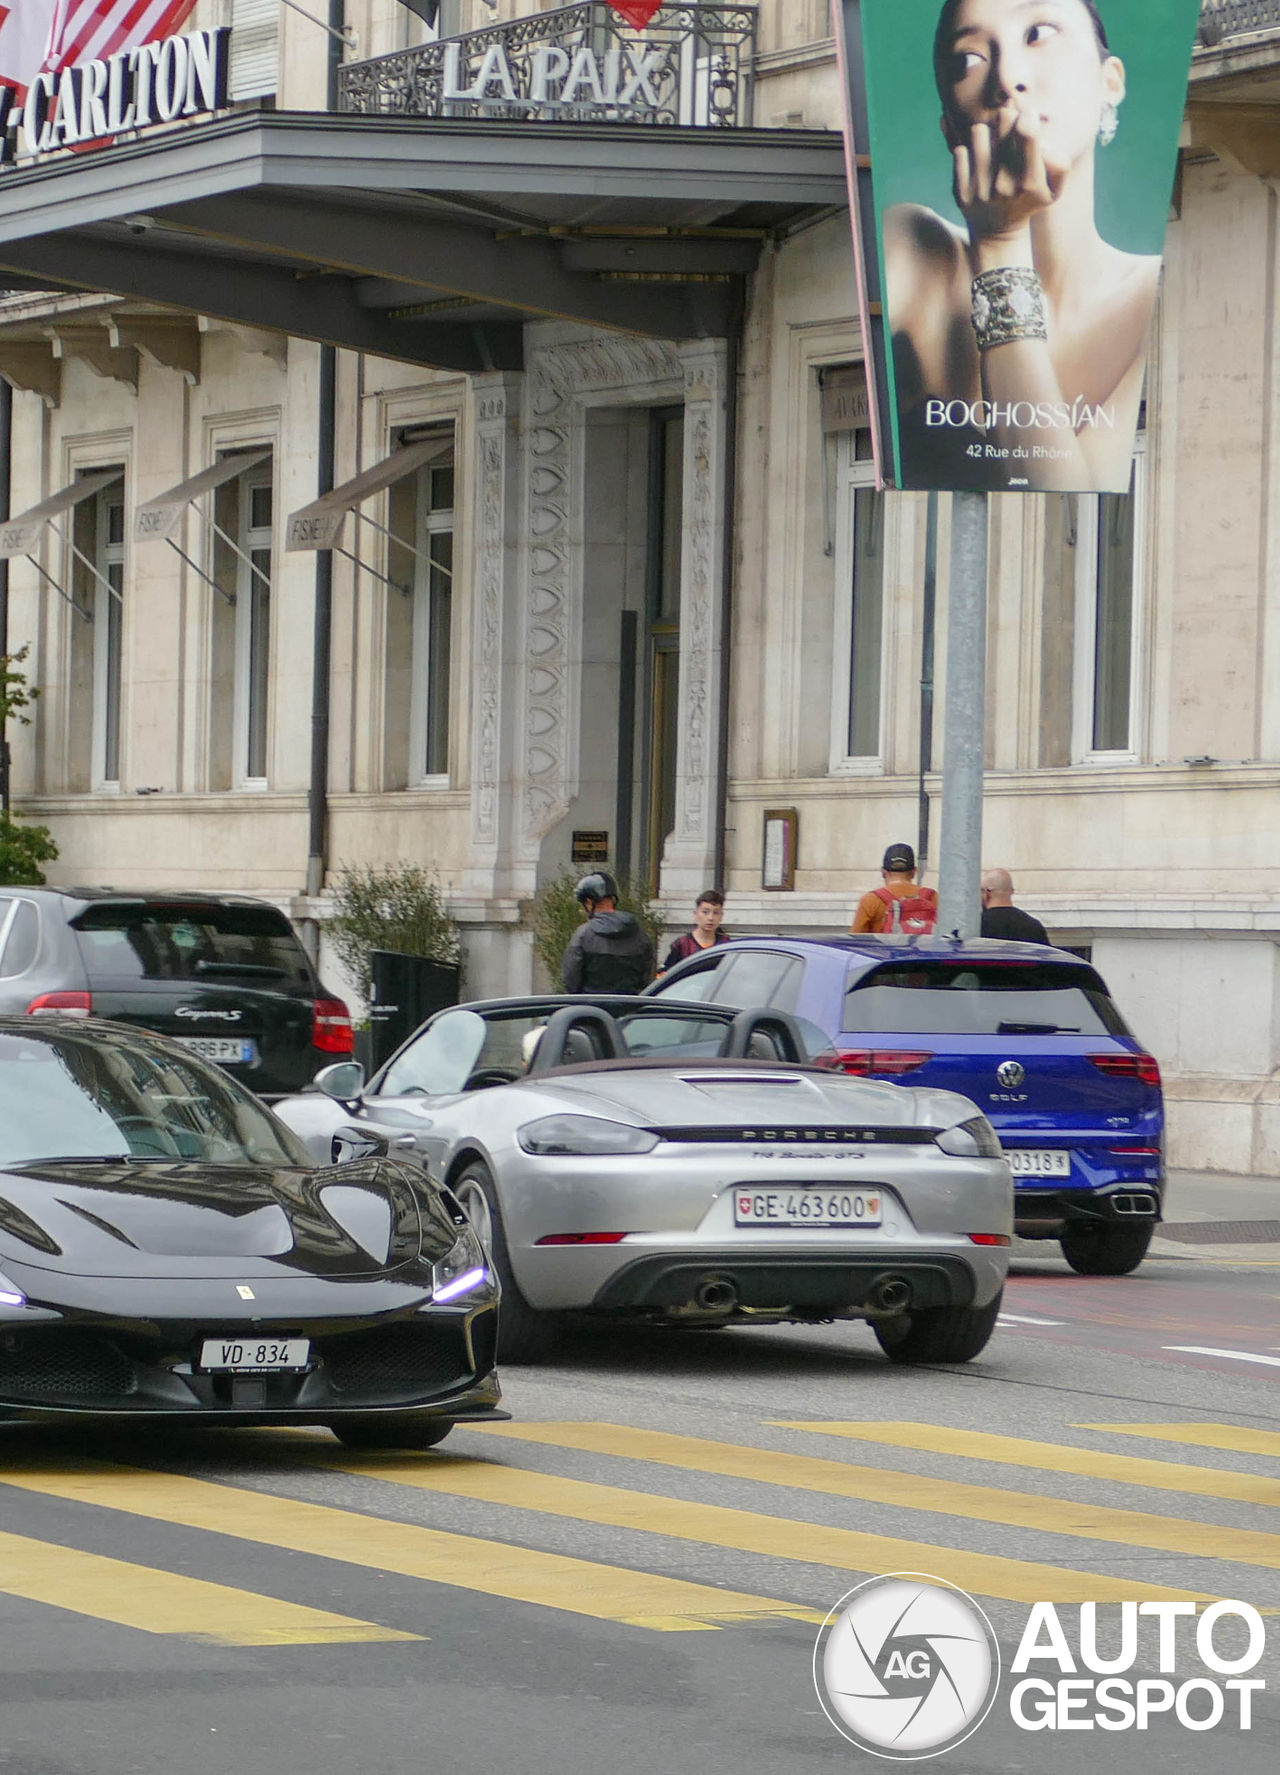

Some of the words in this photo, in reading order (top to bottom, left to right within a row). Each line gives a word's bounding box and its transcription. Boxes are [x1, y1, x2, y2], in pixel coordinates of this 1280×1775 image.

[443, 42, 519, 101] LA
[531, 46, 663, 107] PAIX
[966, 444, 983, 458] 42
[985, 444, 1010, 459] Rue
[1012, 445, 1030, 459] du
[742, 1130, 876, 1140] PORSCHE
